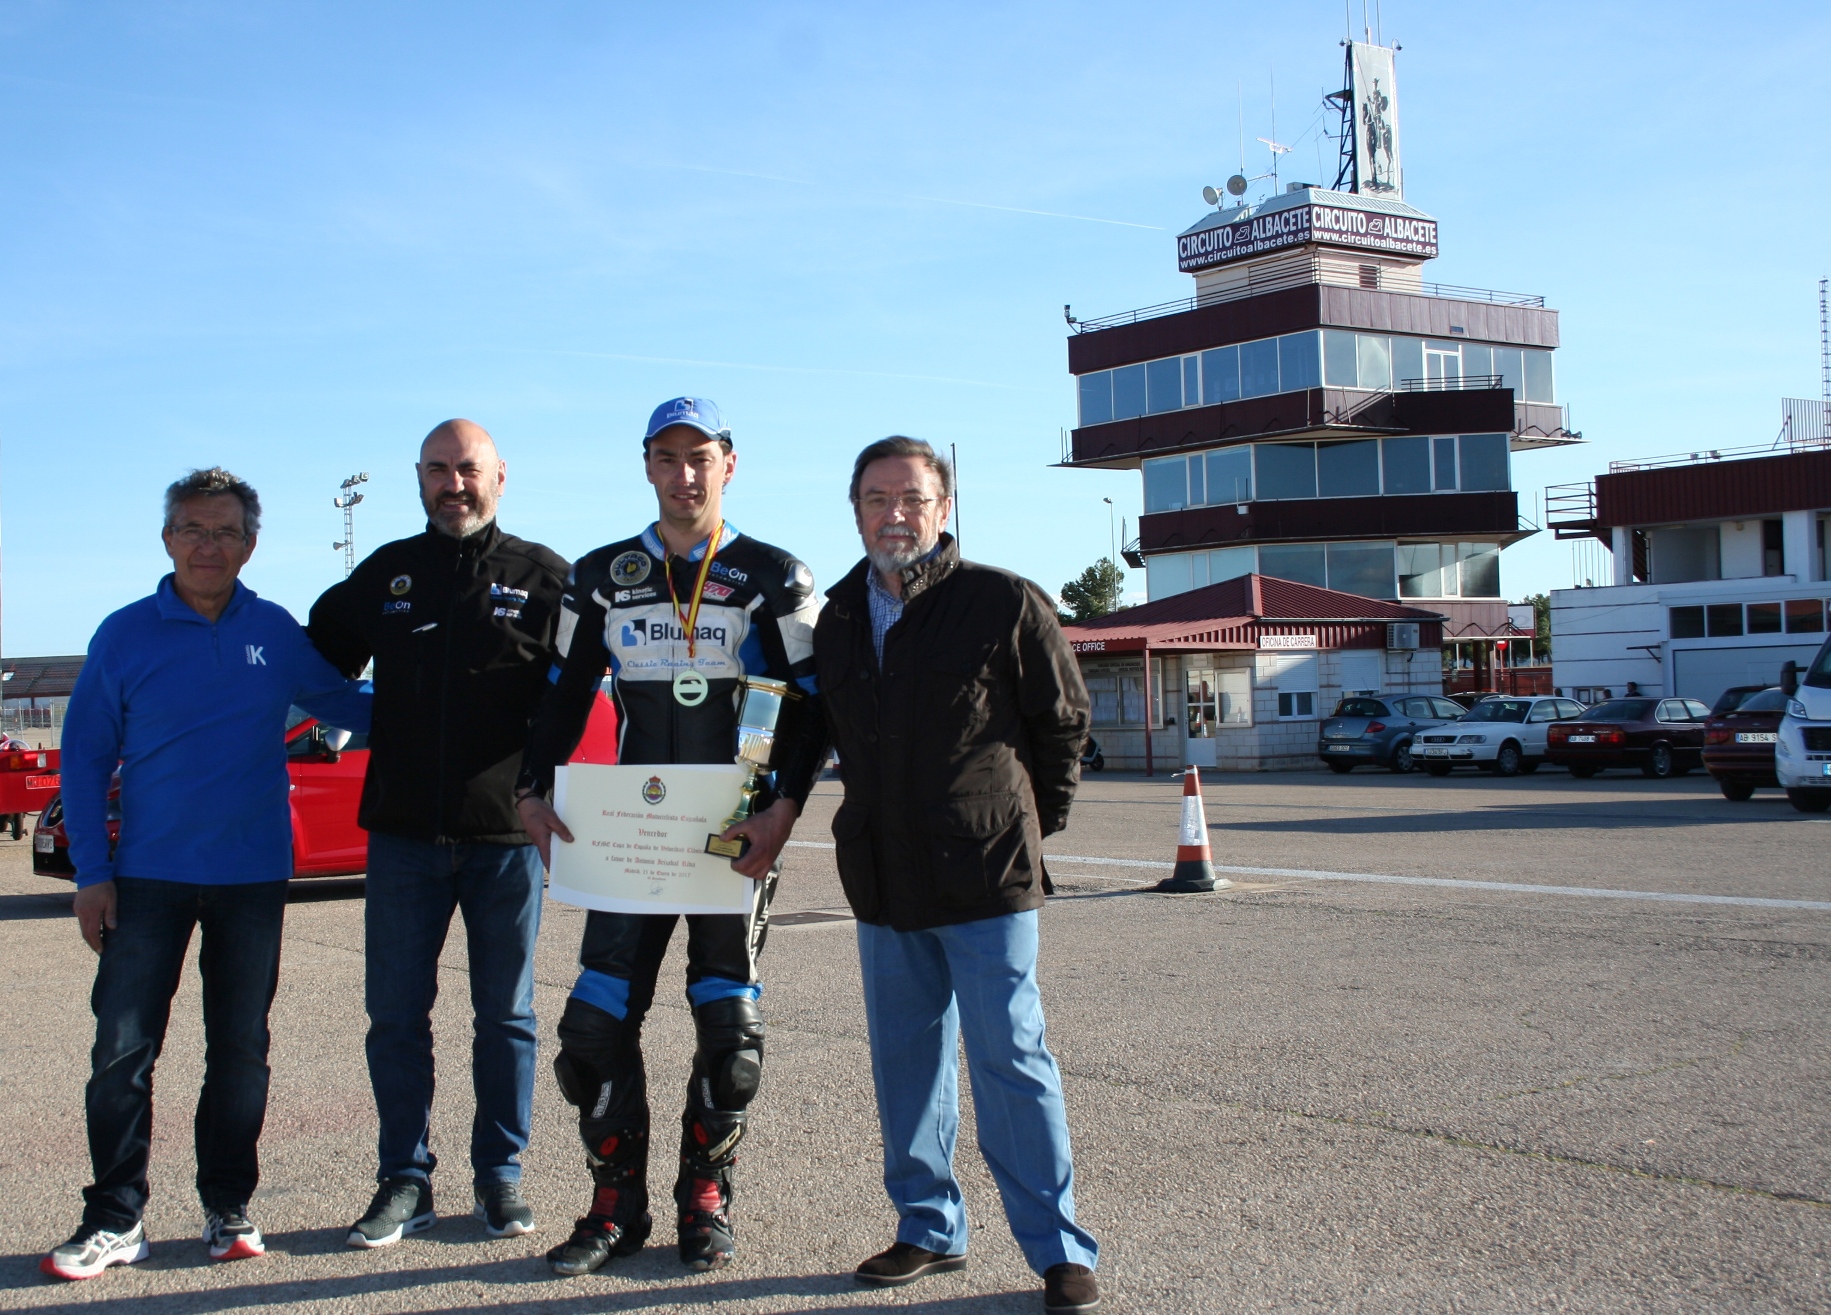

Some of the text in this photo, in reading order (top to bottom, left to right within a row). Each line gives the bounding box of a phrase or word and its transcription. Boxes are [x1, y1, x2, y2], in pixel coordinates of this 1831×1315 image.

[1312, 206, 1437, 244] CIRCUITO ALBACETE
[1179, 207, 1310, 258] CIRCUITO ALBACETE
[1313, 230, 1437, 254] www.circuitoalbacete.es
[1180, 230, 1310, 269] www.circuitoalbacete.es
[710, 561, 748, 582] BeOn
[631, 586, 653, 595] kinetic
[632, 592, 657, 600] services
[384, 600, 411, 611] BeOn
[1072, 641, 1105, 652] CE OFFICE
[1262, 637, 1315, 647] OFICINA DE CARRERA
[627, 658, 726, 668] Classic Racing Team
[1740, 733, 1748, 741] AB
[1751, 733, 1769, 741] 9154
[638, 828, 668, 838] Vencedor
